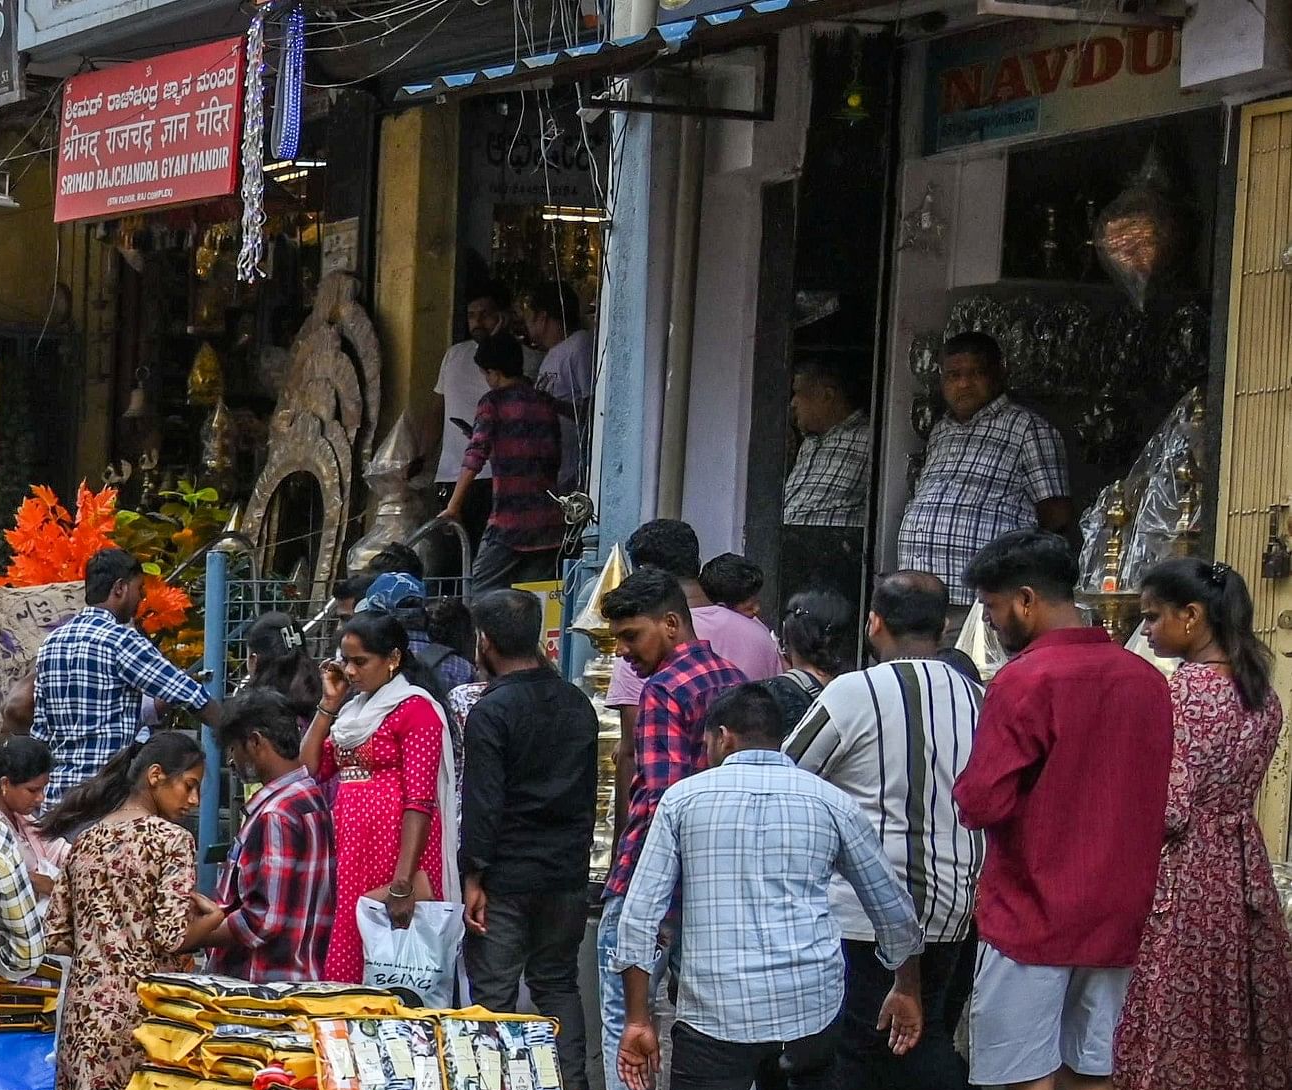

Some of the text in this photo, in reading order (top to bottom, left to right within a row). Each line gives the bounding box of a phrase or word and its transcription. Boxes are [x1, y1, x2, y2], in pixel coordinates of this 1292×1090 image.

[106, 114, 156, 154] राजचंद्र
[160, 112, 191, 147] ज्ञान
[196, 96, 233, 138] मंदिर
[60, 147, 229, 196] SRIMAD RAJCHANDRA GYAN MANDIR
[374, 973, 431, 991] BEING
